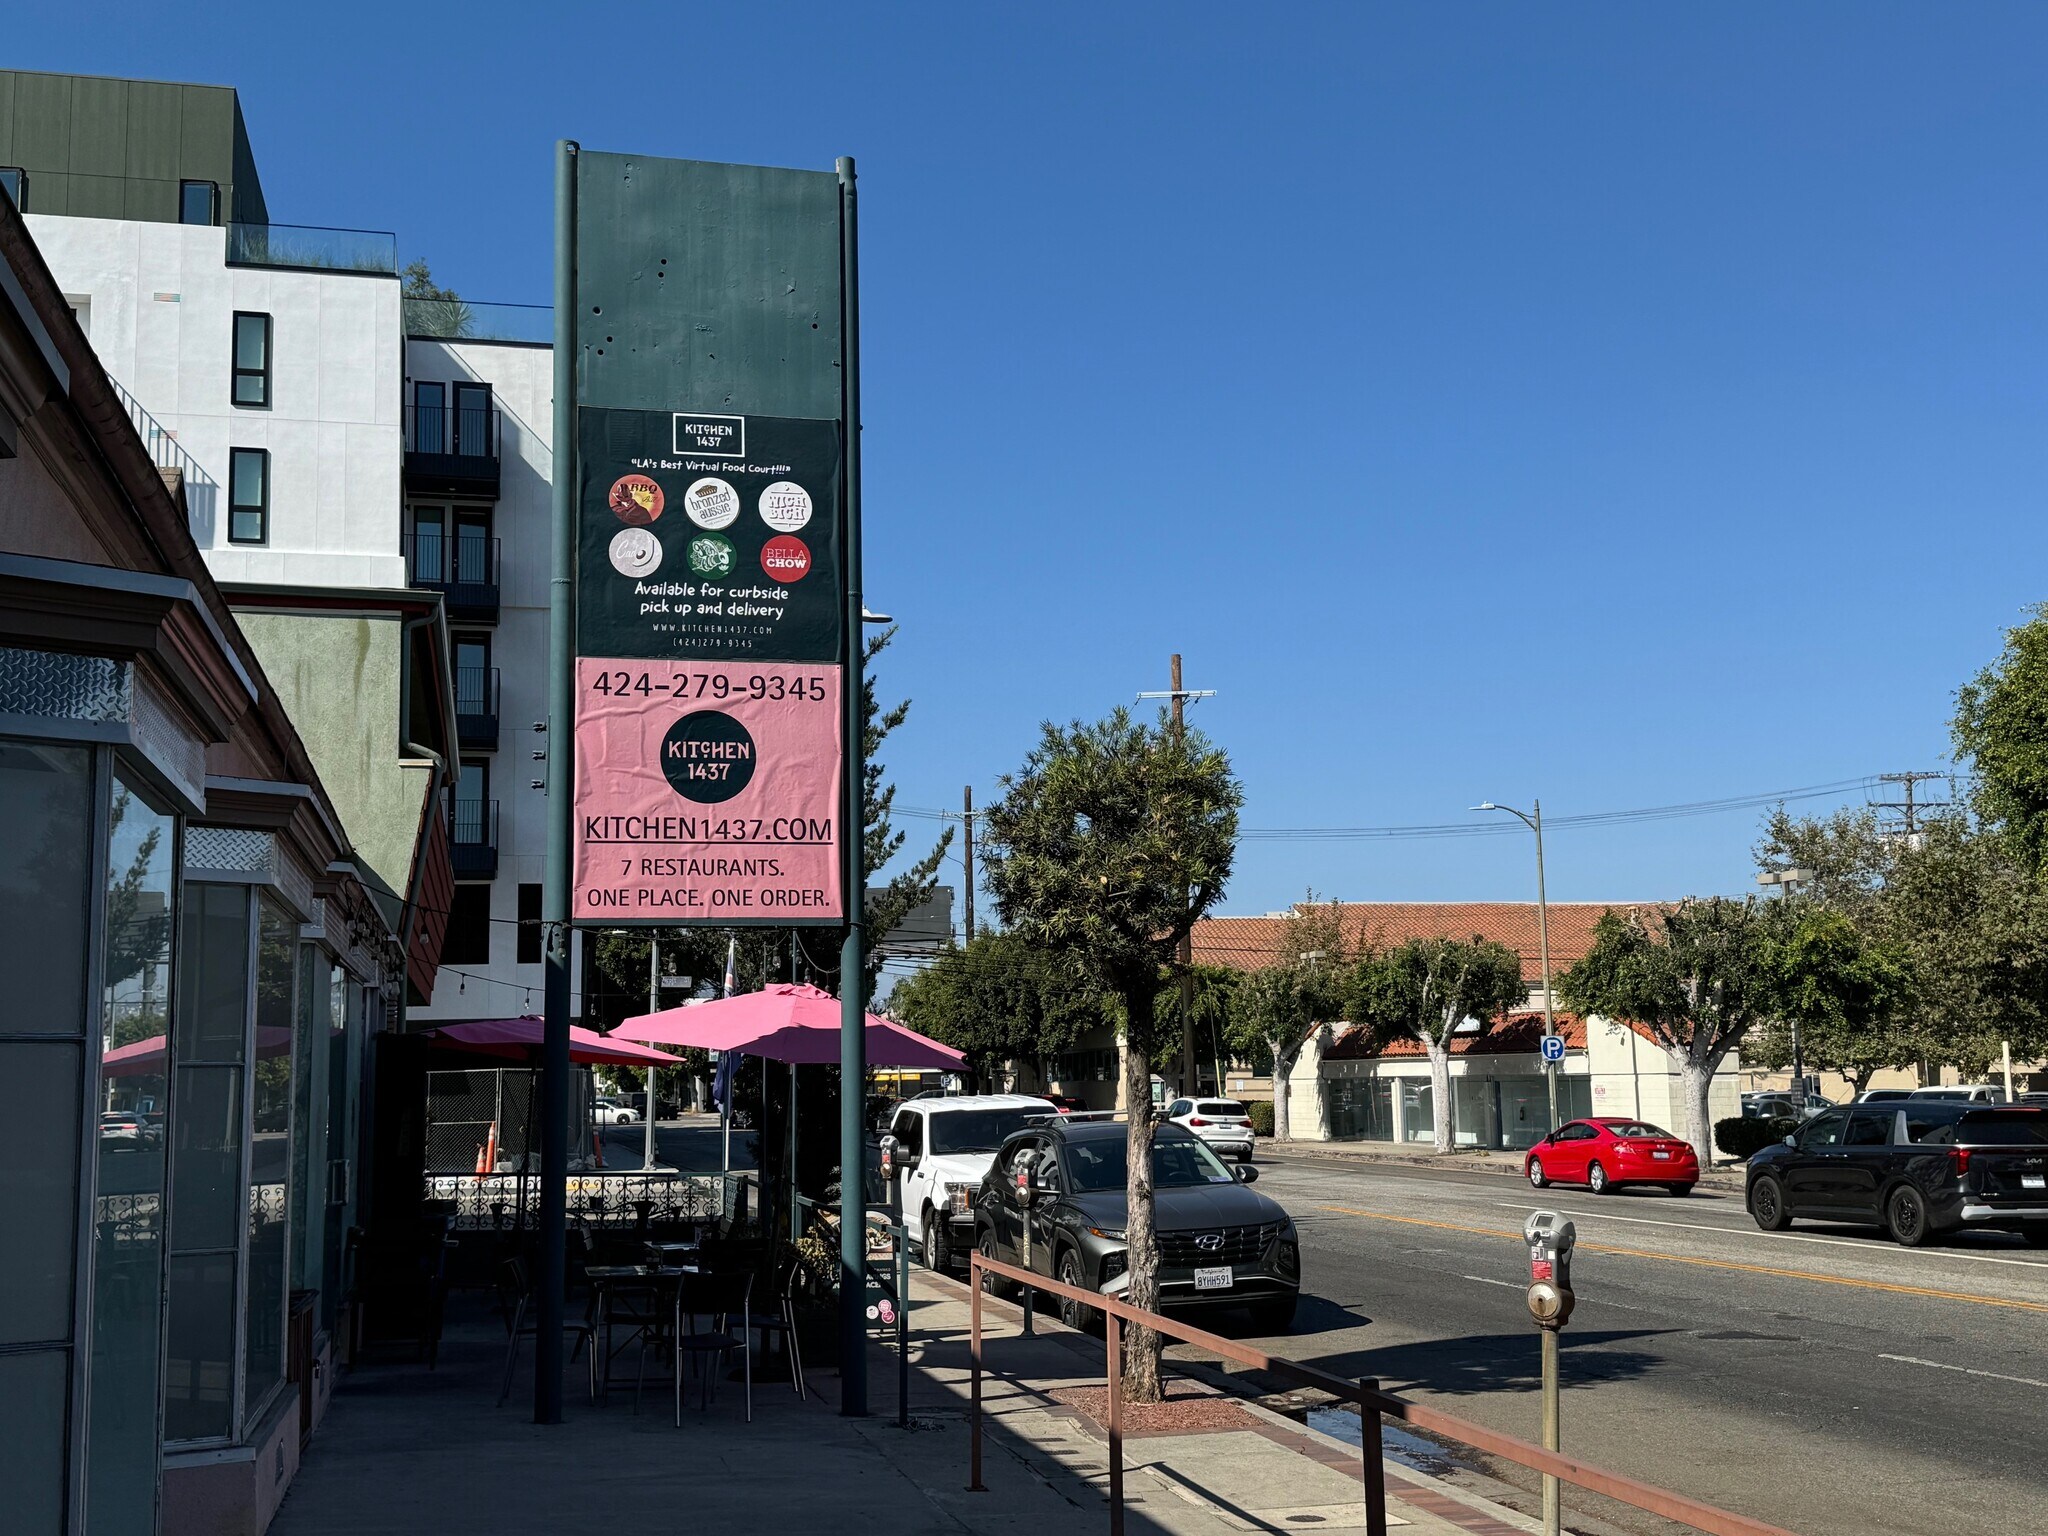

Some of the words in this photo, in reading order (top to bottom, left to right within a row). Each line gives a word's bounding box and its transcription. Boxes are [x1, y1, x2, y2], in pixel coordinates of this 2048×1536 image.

[685, 424, 733, 436] KITCHEN
[697, 437, 721, 447] 1437
[661, 460, 683, 470] Best
[686, 461, 719, 472] Virtual
[723, 463, 745, 473] Food
[766, 548, 806, 559] BELLA
[766, 559, 807, 569] CHOW
[635, 581, 696, 597] Available
[700, 583, 724, 598] for
[729, 584, 789, 600] curbside
[640, 601, 670, 616] pick
[675, 604, 691, 616] up
[697, 602, 722, 616] and
[727, 602, 784, 620] delivery
[653, 624, 772, 635] WWW.KITCHEN1437.COM
[673, 638, 752, 648] (424)279-9345
[593, 672, 826, 701] 424-279-9345
[668, 741, 750, 759] KITCHEN
[687, 763, 731, 780] 1437
[586, 816, 832, 841] KITCHEN1437.COM
[621, 859, 632, 876] 7
[641, 859, 785, 877] RESTAURANTS.
[588, 889, 629, 906] ONE
[639, 890, 704, 906] PLACE.
[712, 890, 753, 906] ONE
[761, 890, 830, 907] ORDER.
[1198, 1275, 1230, 1287] 8YHH591
